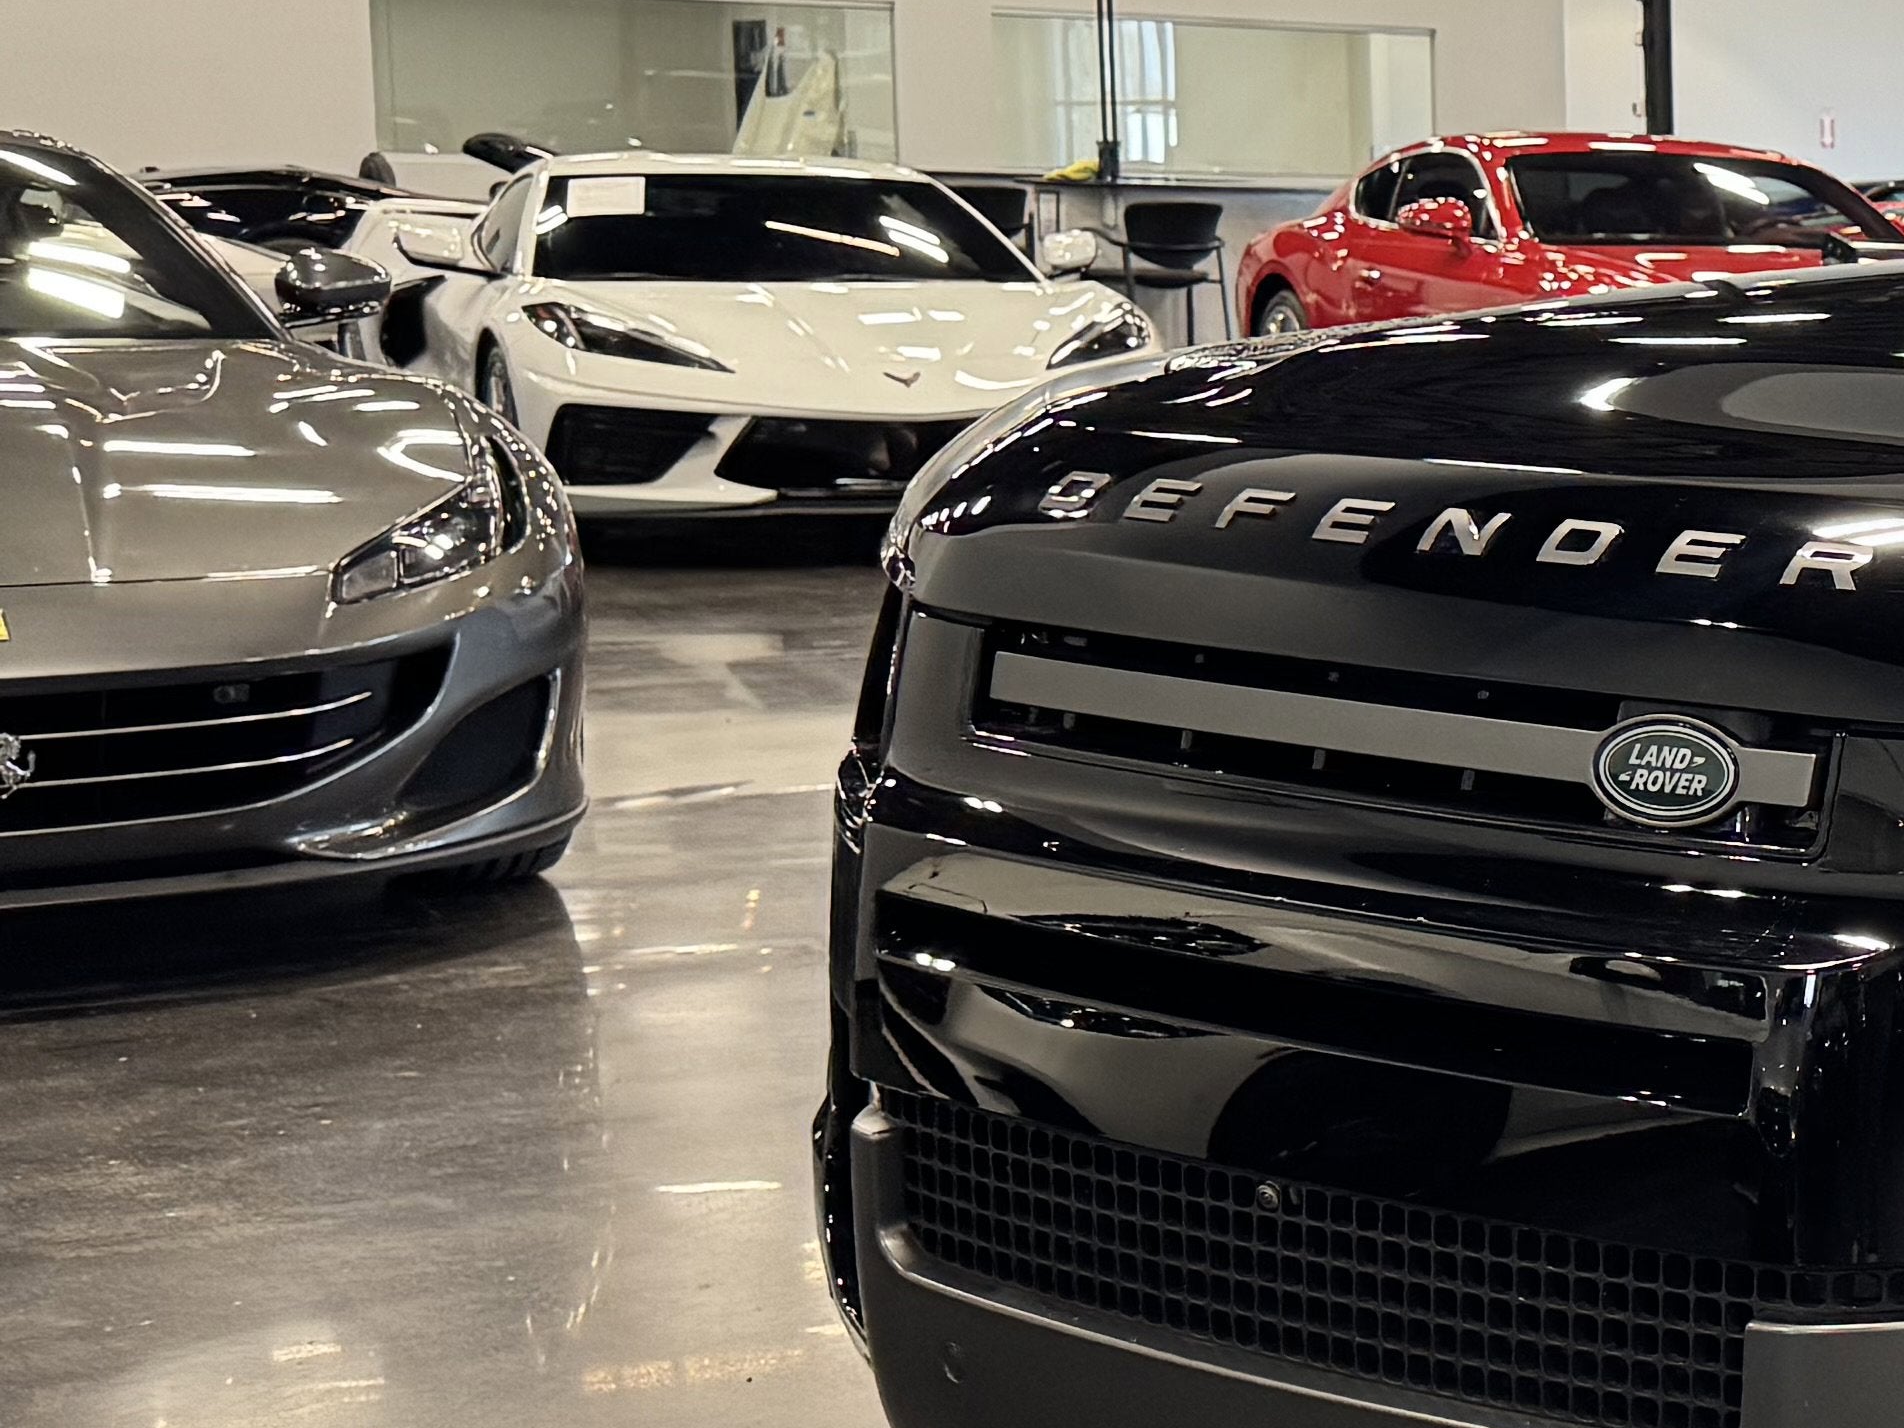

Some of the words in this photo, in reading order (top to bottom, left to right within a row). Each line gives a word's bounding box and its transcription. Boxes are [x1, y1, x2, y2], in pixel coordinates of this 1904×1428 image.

[1041, 471, 1876, 591] DEFENDER
[1628, 743, 1692, 770] LAND
[1629, 768, 1708, 797] ROVER
